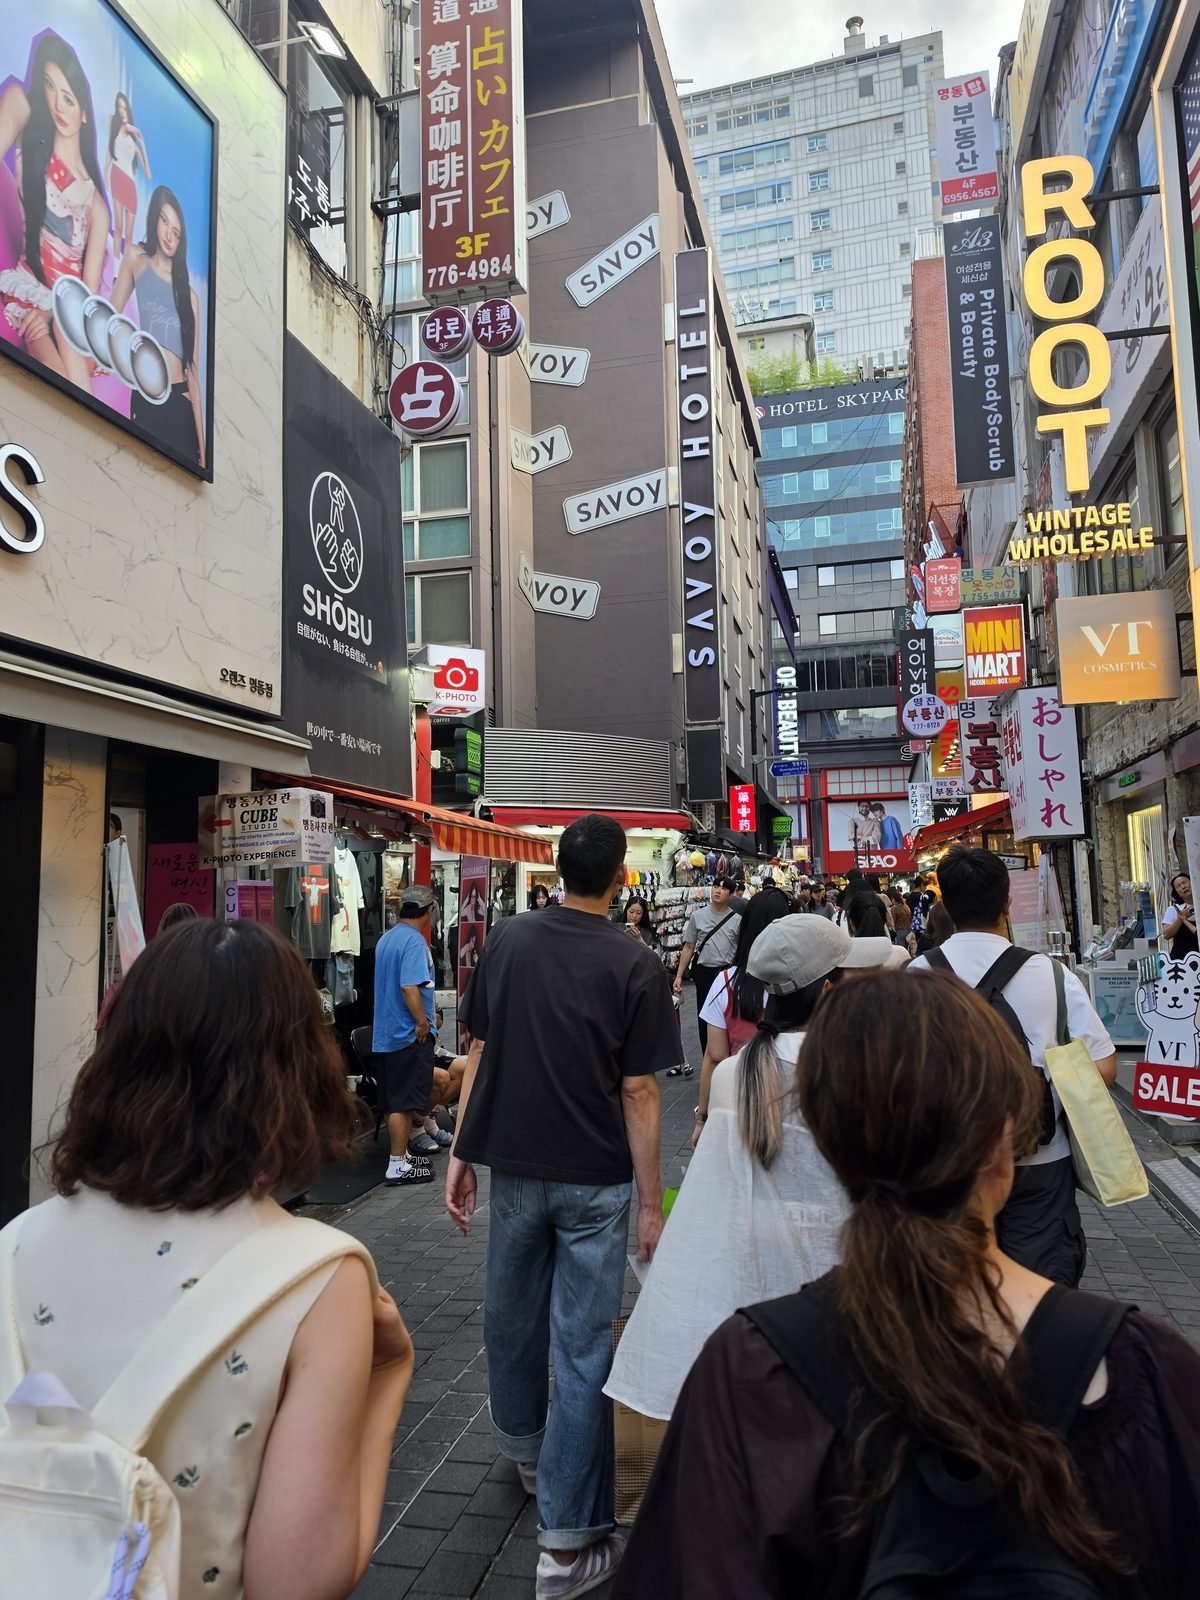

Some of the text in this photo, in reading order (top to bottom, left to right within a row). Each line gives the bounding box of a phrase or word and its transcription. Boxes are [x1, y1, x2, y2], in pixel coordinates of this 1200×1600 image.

[427, 41, 463, 230] 算命咖啡厅
[952, 102, 979, 173] 부동산
[944, 186, 997, 204] 6956.4567
[962, 179, 976, 189] 4F
[455, 233, 490, 258] 3F
[427, 254, 512, 288] 776-4984
[580, 225, 658, 294] SAVOY
[955, 261, 992, 274] 여성전용
[426, 317, 462, 342] 타로
[478, 322, 513, 342] 사주
[959, 292, 978, 379] & Beauty
[1021, 155, 1112, 493] ROOT
[439, 342, 449, 350] 3F
[980, 288, 1006, 472] Private BodyScrub
[400, 366, 445, 421] 占
[769, 398, 828, 416] HOTEL
[680, 299, 715, 667] SAVOY HOTEL
[576, 479, 662, 523] SAVOY
[1026, 503, 1132, 533] VINTAGE
[1009, 527, 1155, 561] WHOLESALE
[928, 573, 959, 586] 익선동
[961, 567, 1015, 582] 명동사
[971, 590, 1018, 601] 755-9475
[966, 618, 1021, 654] MINI
[1080, 621, 1153, 657] VT
[967, 652, 1021, 679] MART
[1083, 660, 1157, 674] COSMETICS
[249, 677, 273, 699] 명동점
[435, 691, 477, 702] K-PHOTO
[907, 706, 945, 721] 부동산
[964, 720, 1005, 793] 부동산
[1032, 696, 1073, 828] おしゃれ
[226, 792, 291, 809] 명동사진관
[240, 808, 279, 824] CUBE
[241, 822, 278, 831] STUDIO
[302, 819, 334, 834] 명동사진관
[203, 850, 297, 864] K-PHOTO EXPERIENCE
[857, 854, 898, 869] SPAO
[1158, 1040, 1187, 1061] VT
[1138, 1072, 1200, 1107] SALE
